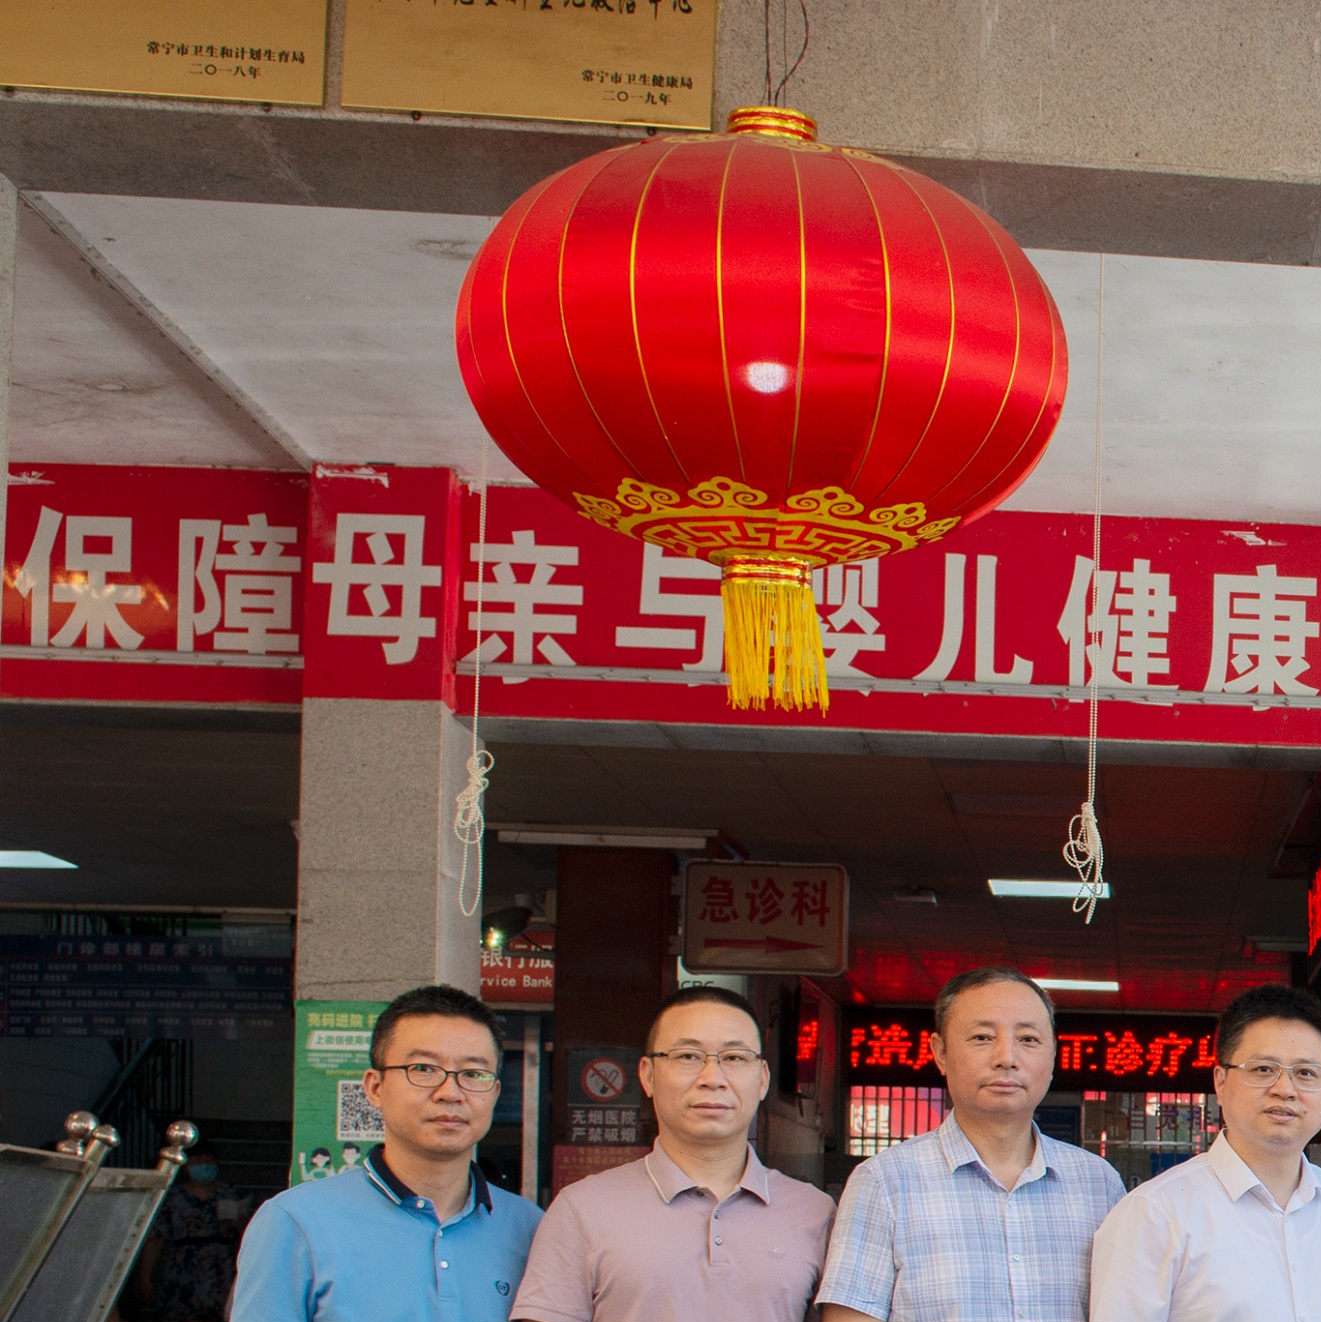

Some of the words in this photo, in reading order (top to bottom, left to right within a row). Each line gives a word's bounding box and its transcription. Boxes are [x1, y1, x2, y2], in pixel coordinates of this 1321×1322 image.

[146, 41, 306, 64] 常宁市卫生和计划生育局
[581, 69, 693, 90] 常宁市卫生健康局
[700, 876, 830, 927] 急诊科
[523, 975, 552, 987] Bank
[571, 1109, 637, 1125] 无烟医院
[571, 1127, 637, 1143] 严禁吸烟
